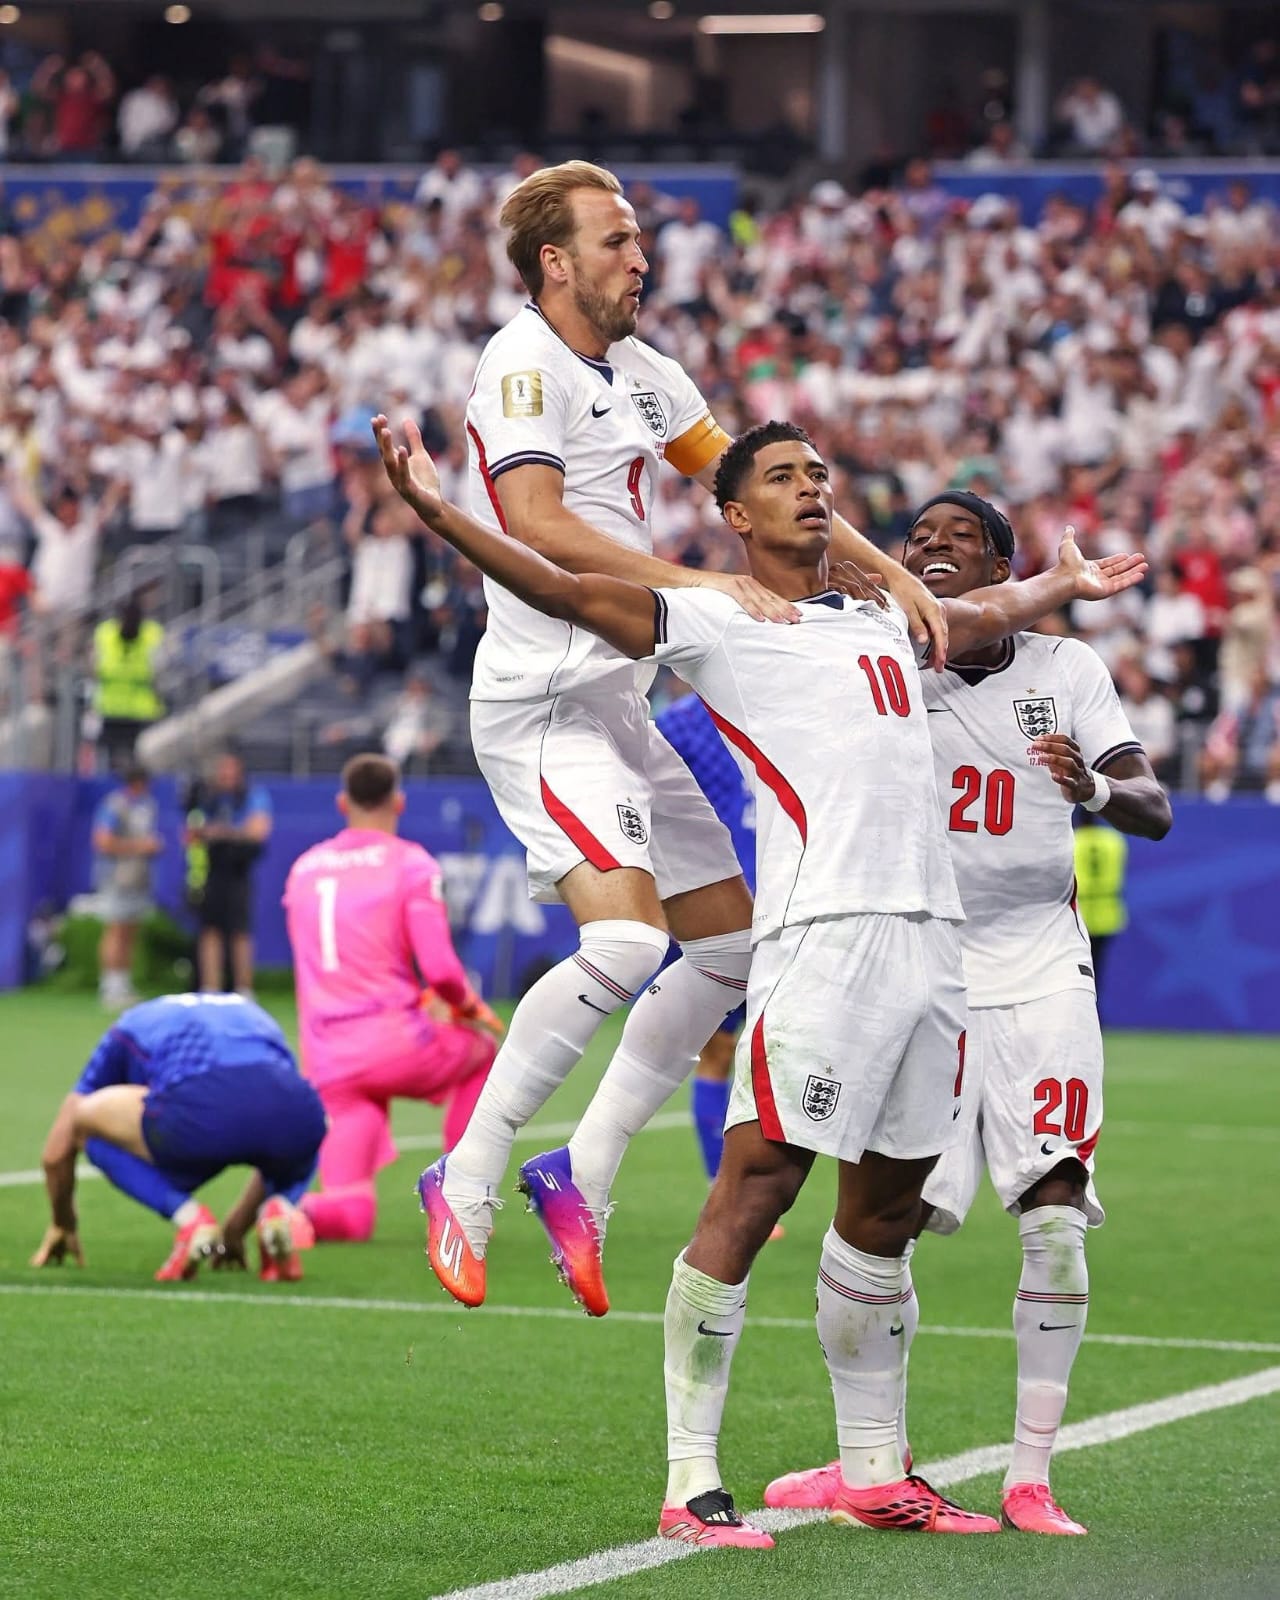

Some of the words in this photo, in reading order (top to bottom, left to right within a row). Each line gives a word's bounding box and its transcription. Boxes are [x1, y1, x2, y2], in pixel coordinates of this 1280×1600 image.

[627, 456, 645, 521] 9
[857, 655, 911, 717] 10
[949, 765, 1016, 836] 20
[315, 876, 341, 972] 1
[1033, 1077, 1089, 1142] 20
